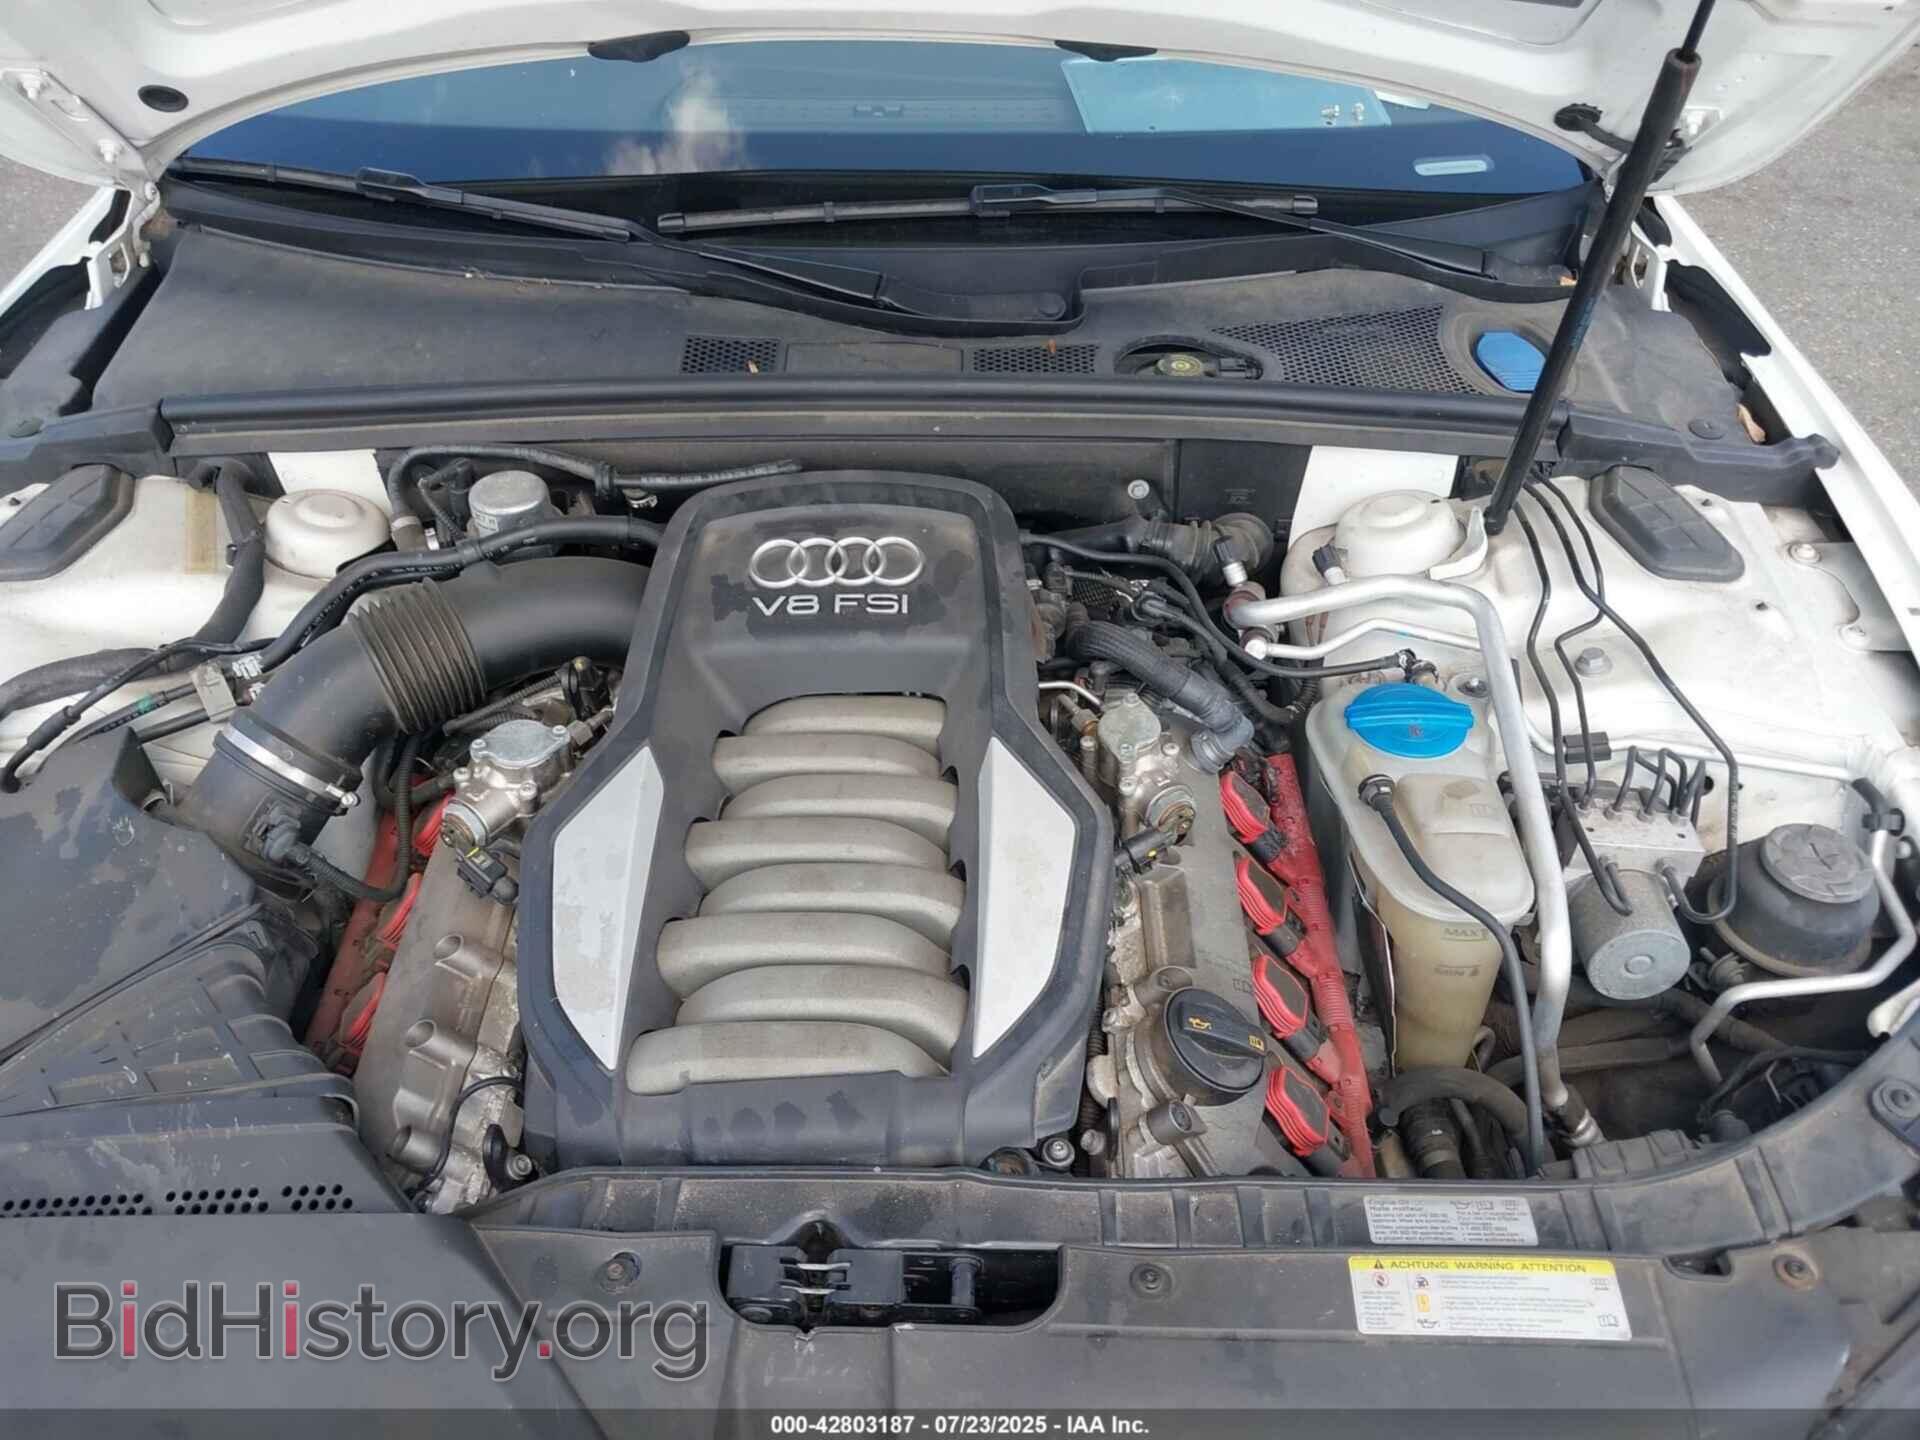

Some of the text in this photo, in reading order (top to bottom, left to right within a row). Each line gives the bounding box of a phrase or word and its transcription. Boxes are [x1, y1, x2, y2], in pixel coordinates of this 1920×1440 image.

[752, 593, 908, 617] V8 FSI
[1443, 927, 1479, 937] MAX
[1390, 1260, 1587, 1273] ACHTUNG WARNING ATTENTION
